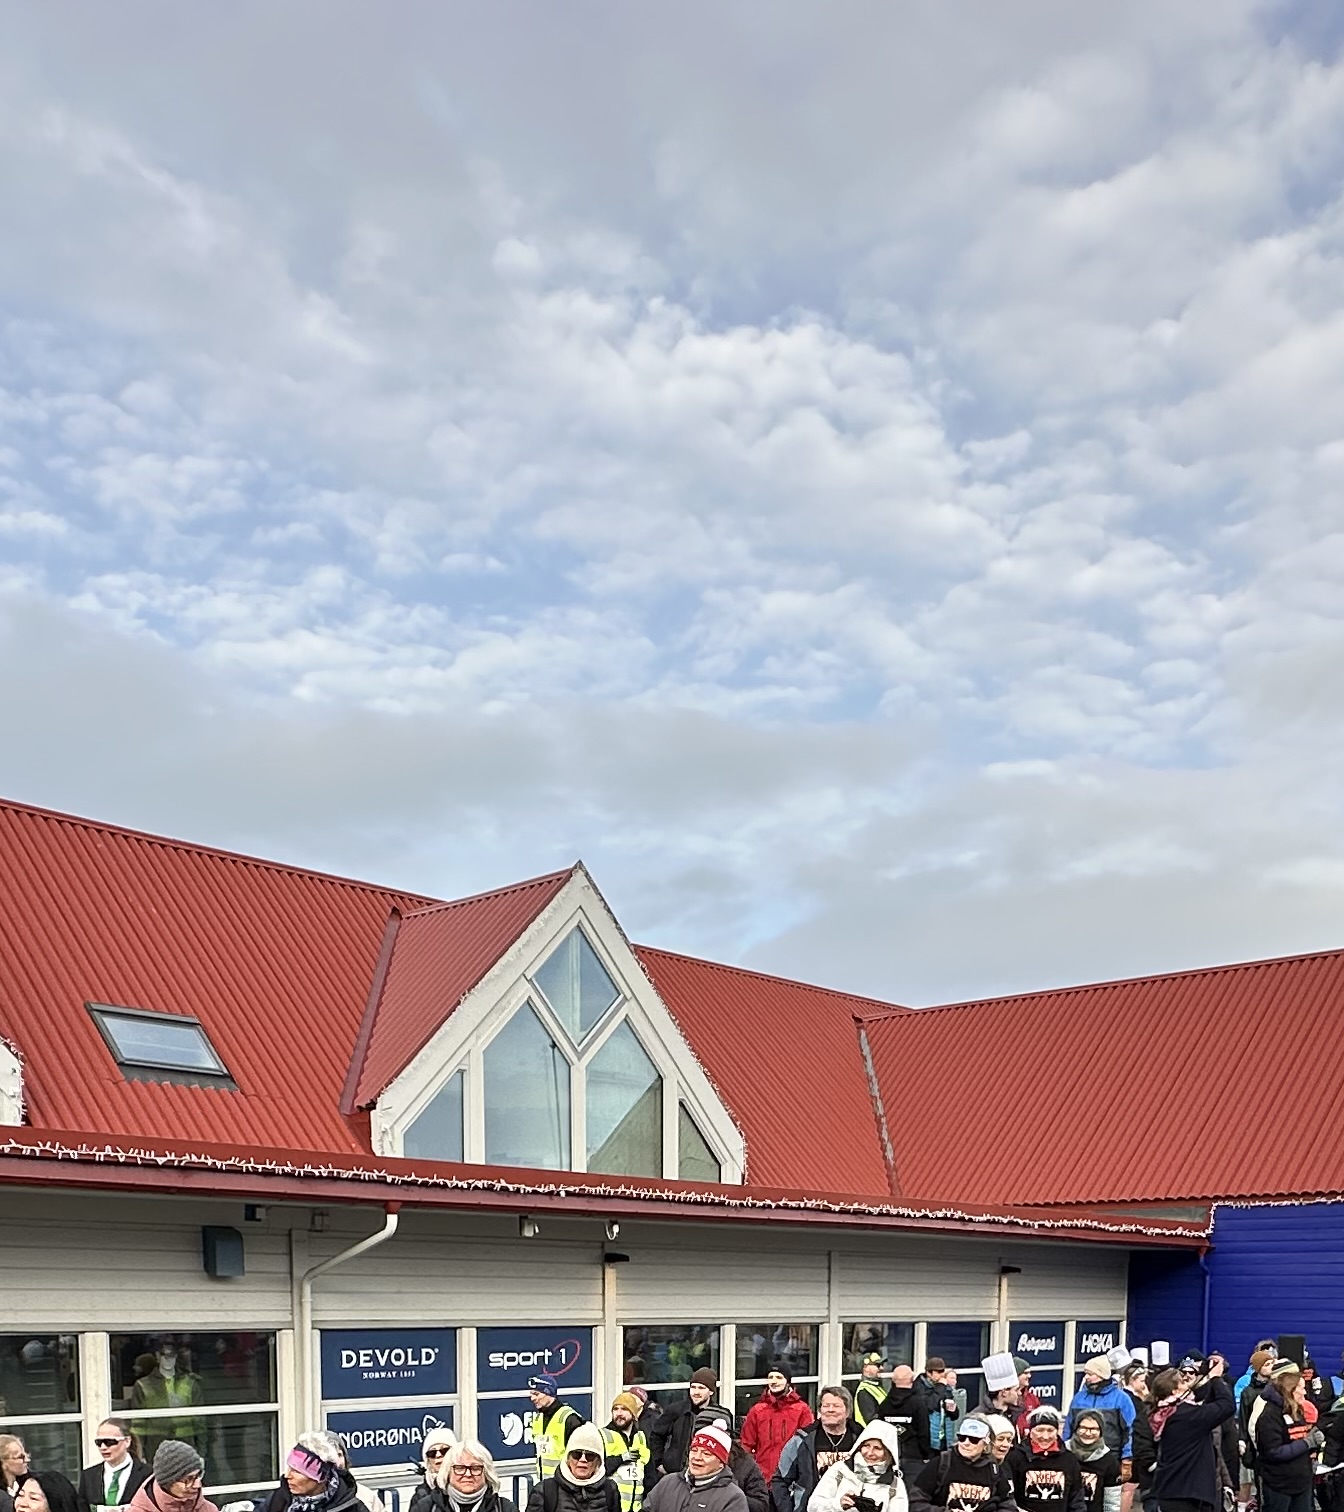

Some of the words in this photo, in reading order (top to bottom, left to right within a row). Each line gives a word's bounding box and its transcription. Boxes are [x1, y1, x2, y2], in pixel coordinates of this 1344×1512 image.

[1081, 1333, 1113, 1354] HOKA
[340, 1347, 436, 1368] DEVOLD
[488, 1348, 552, 1371] sport
[559, 1347, 566, 1365] 1
[362, 1371, 397, 1380] NORWAY
[1029, 1384, 1056, 1398] omon
[339, 1427, 423, 1449] NORRØNA
[626, 1467, 638, 1479] 15
